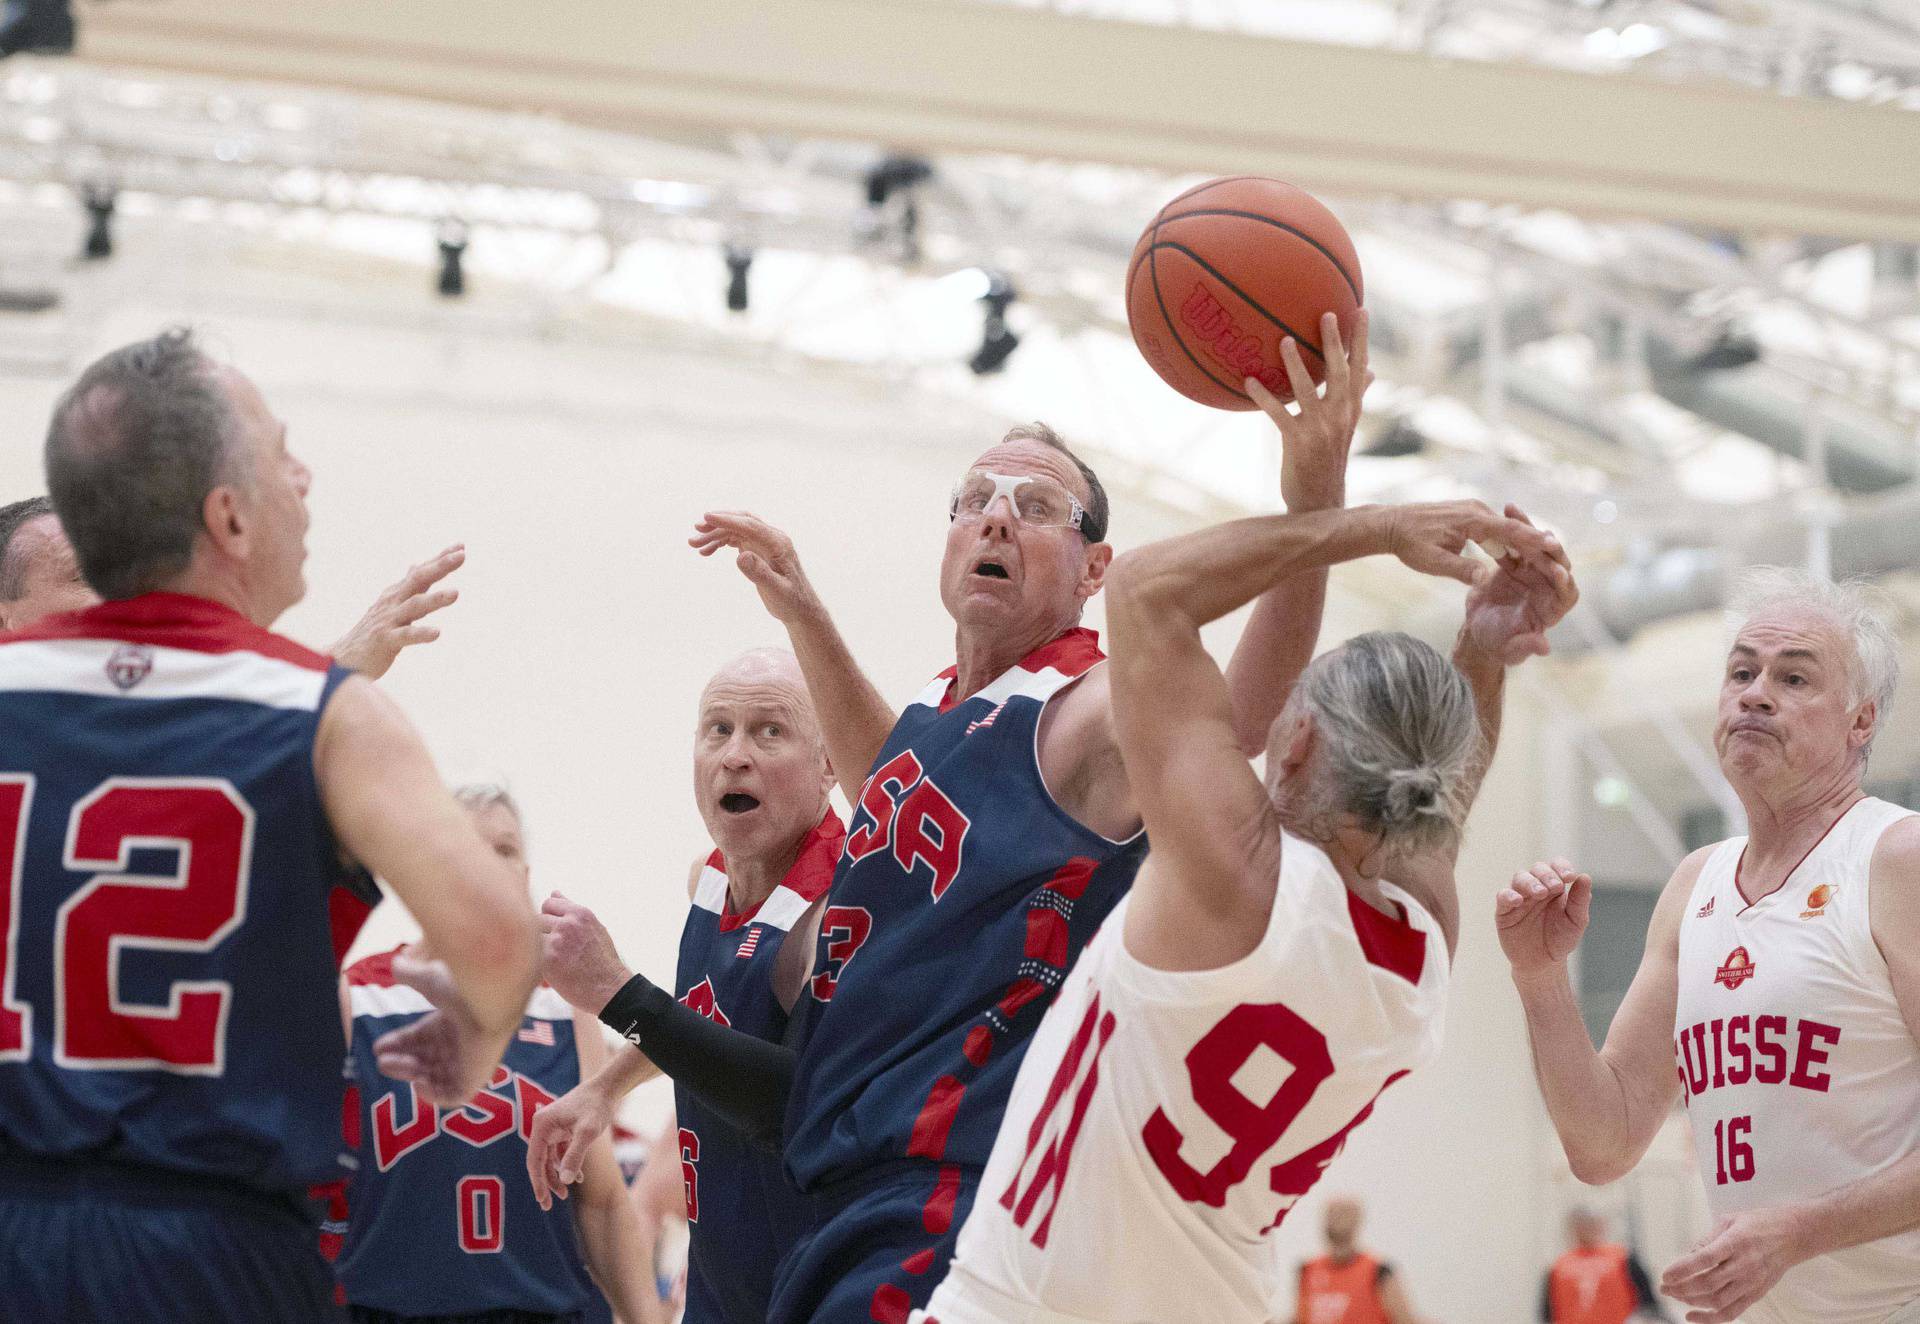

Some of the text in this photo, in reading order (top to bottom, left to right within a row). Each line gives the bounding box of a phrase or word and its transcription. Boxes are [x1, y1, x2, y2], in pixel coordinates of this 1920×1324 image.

[1181, 281, 1296, 398] Wilso
[837, 748, 971, 904] SA
[0, 772, 256, 1077] 12
[1674, 1015, 1841, 1108] UISSE
[1714, 1115, 1755, 1185] 16
[456, 1174, 506, 1254] 0
